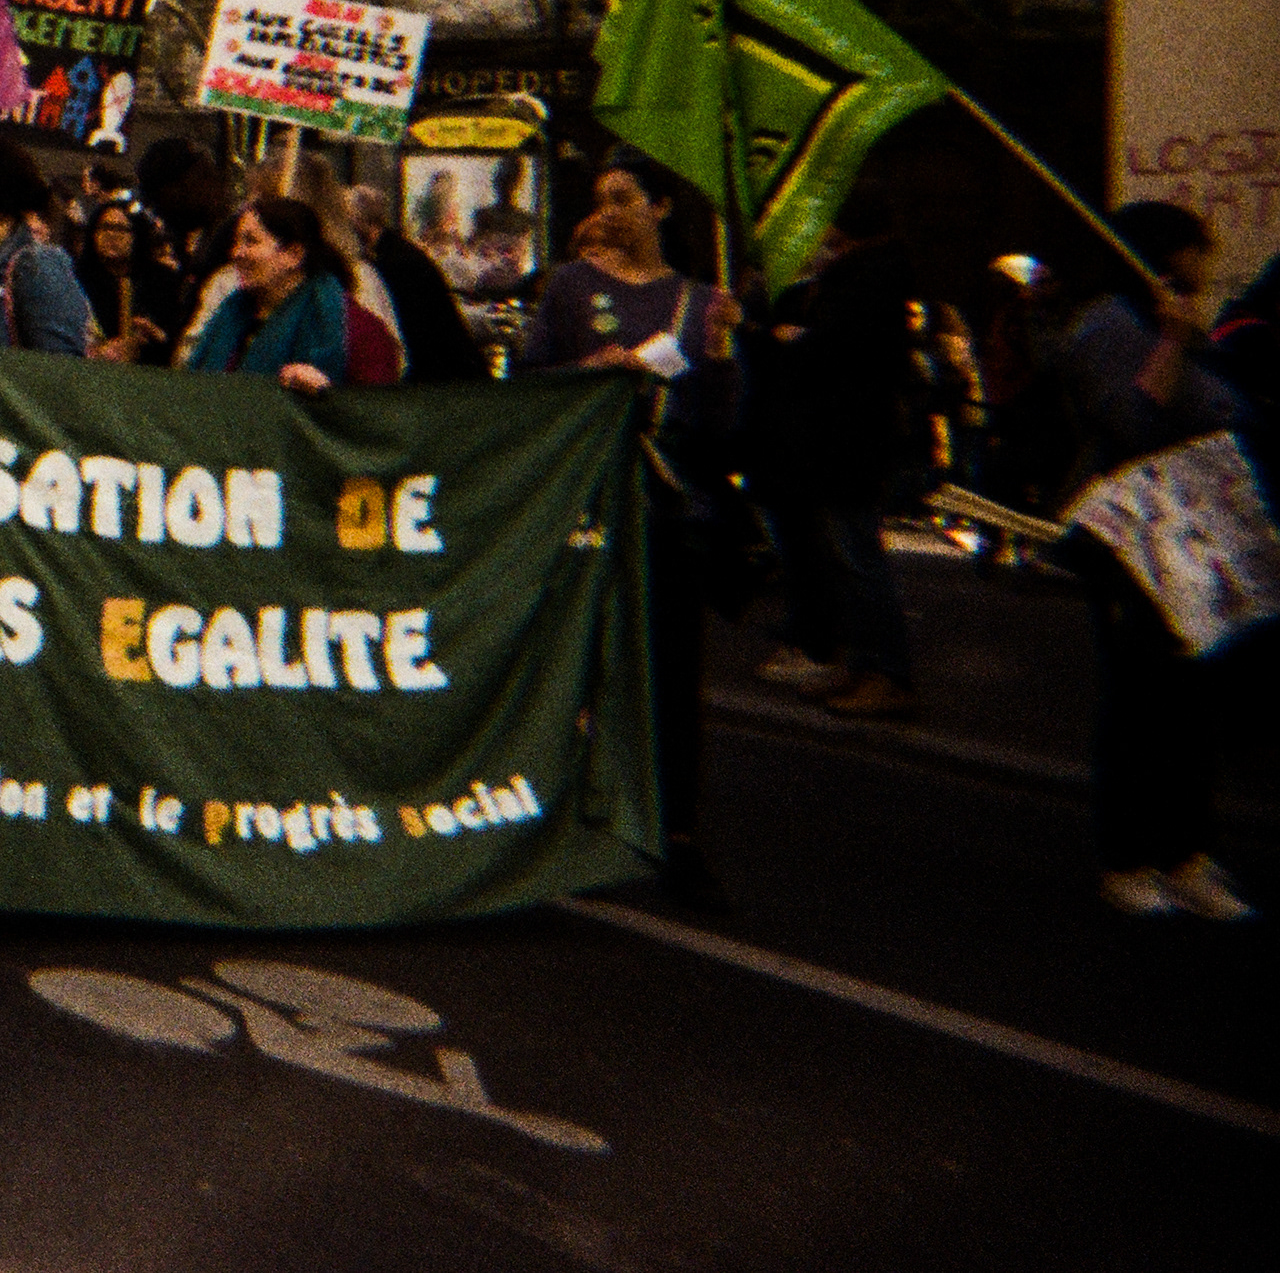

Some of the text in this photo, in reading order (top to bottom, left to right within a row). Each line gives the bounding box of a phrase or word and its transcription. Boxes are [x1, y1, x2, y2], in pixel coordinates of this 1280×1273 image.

[10, 8, 142, 57] CEMENT
[338, 474, 444, 554] DE
[100, 596, 449, 692] EGALITE
[65, 782, 113, 824] et
[139, 785, 186, 834] le
[397, 772, 541, 837] social
